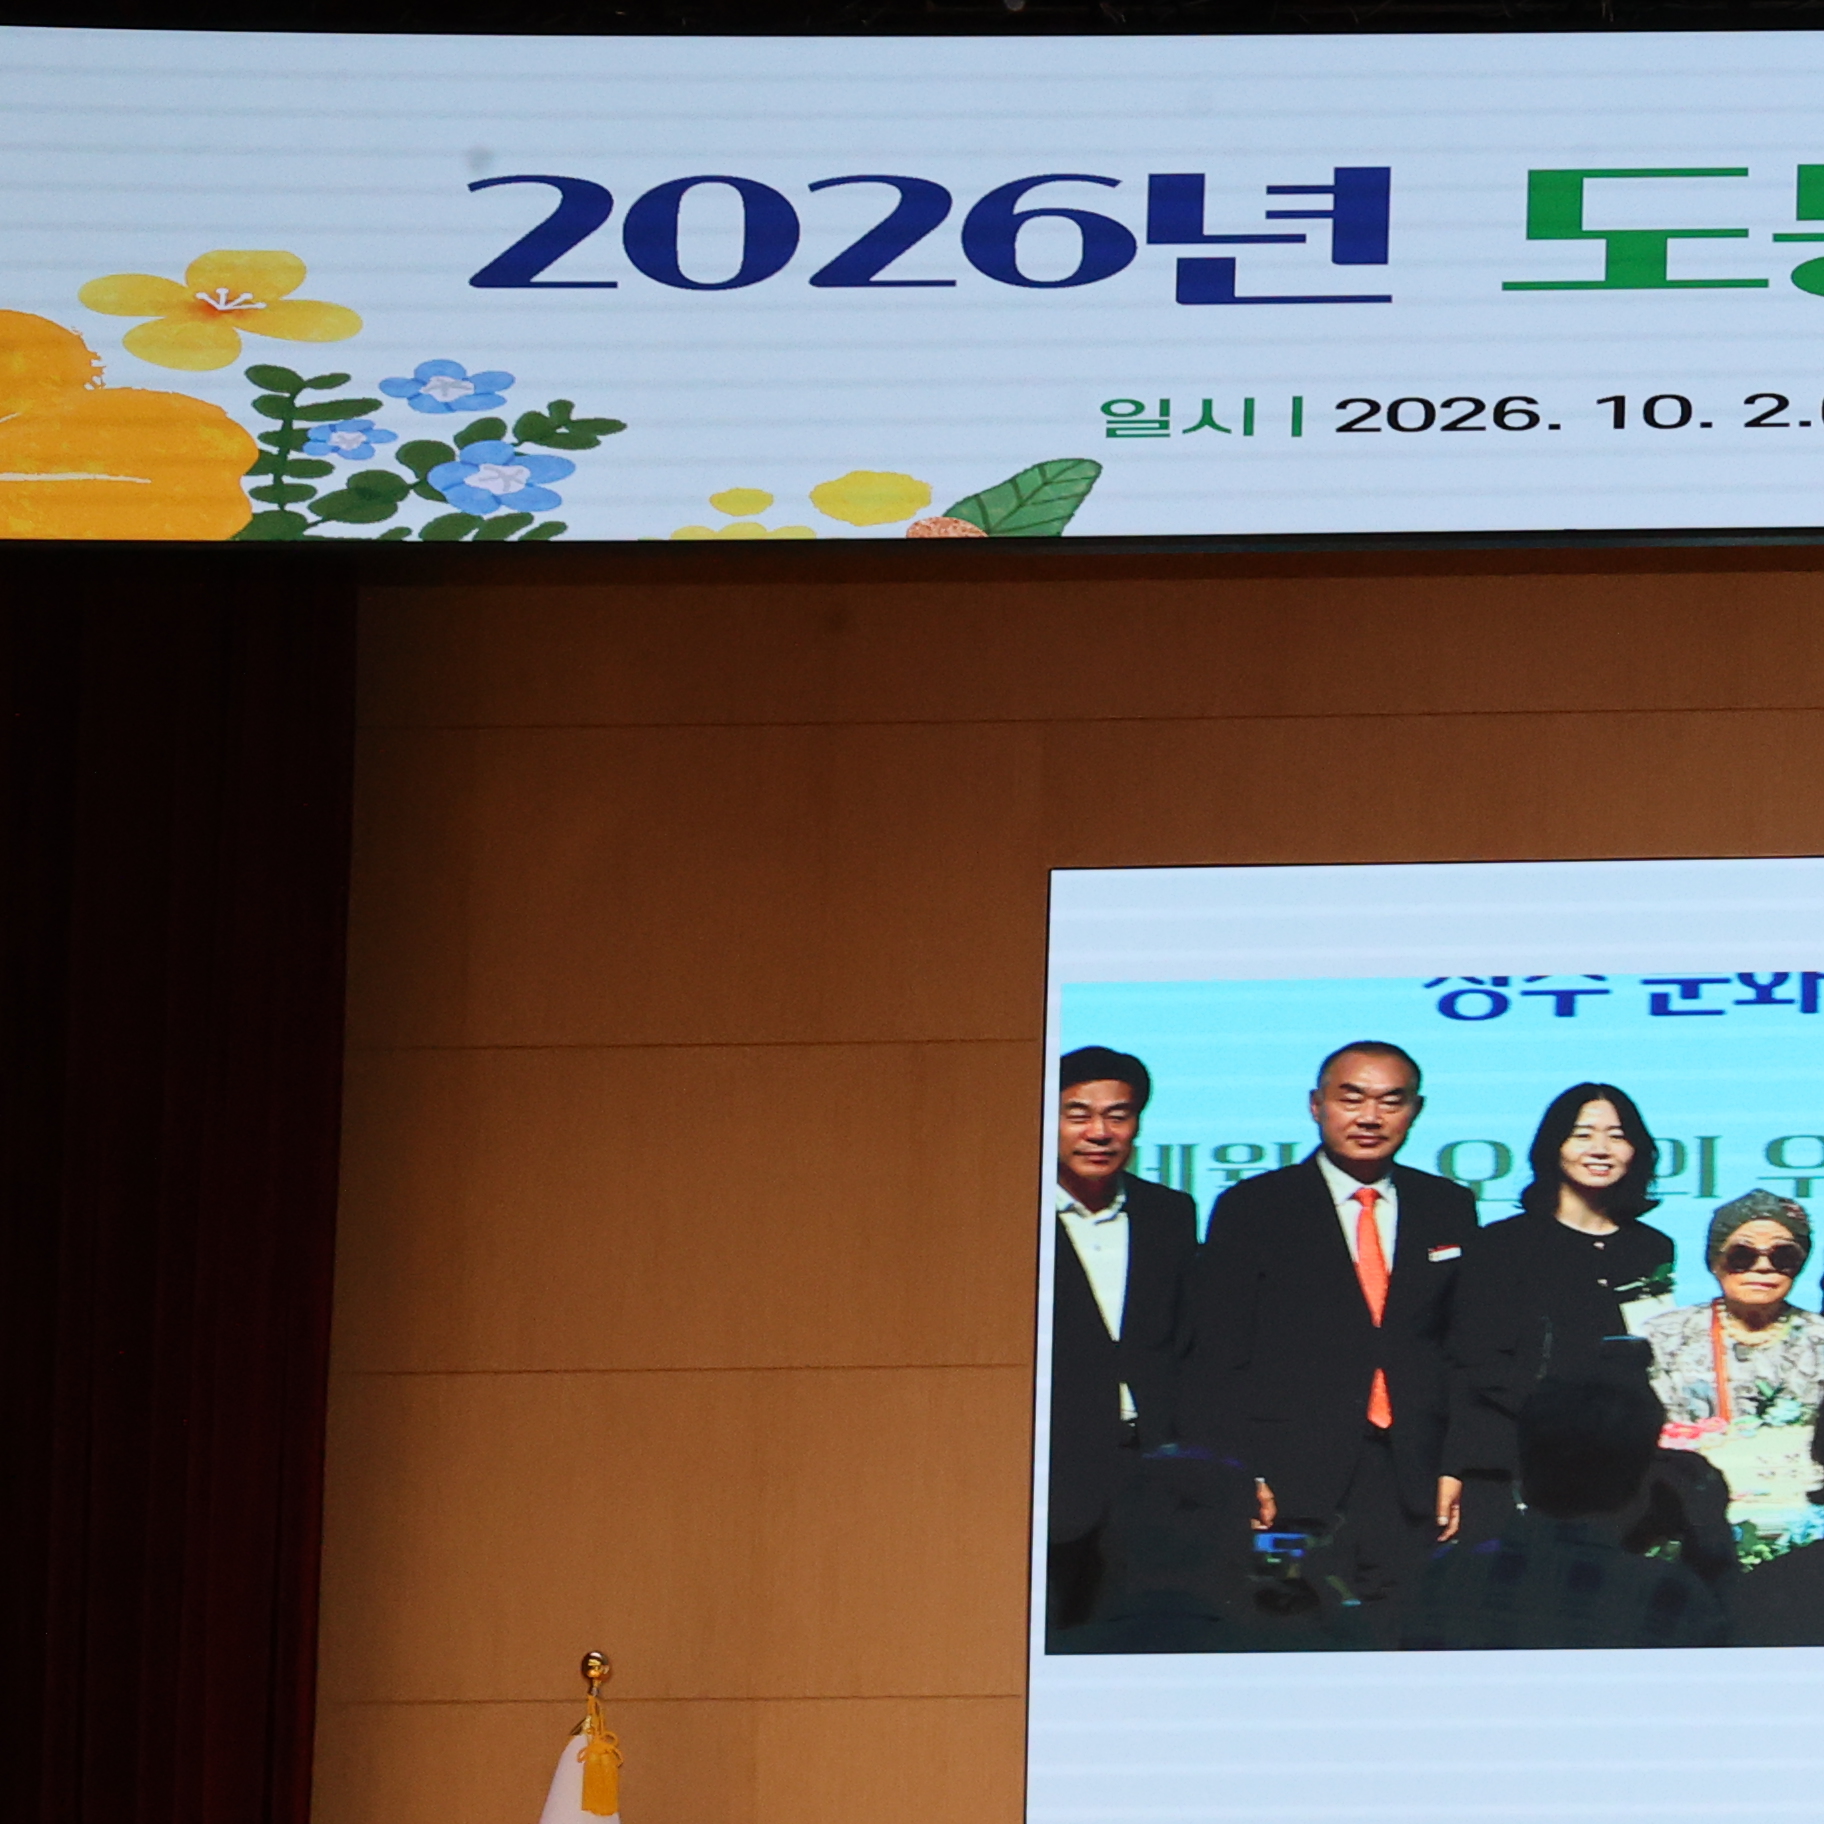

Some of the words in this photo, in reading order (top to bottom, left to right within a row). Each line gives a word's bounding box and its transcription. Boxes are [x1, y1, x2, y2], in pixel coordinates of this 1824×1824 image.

[466, 165, 1393, 306] 2026년
[1099, 396, 1256, 439] 일시
[1334, 393, 1561, 433] 2026.
[1595, 392, 1713, 430] 10.
